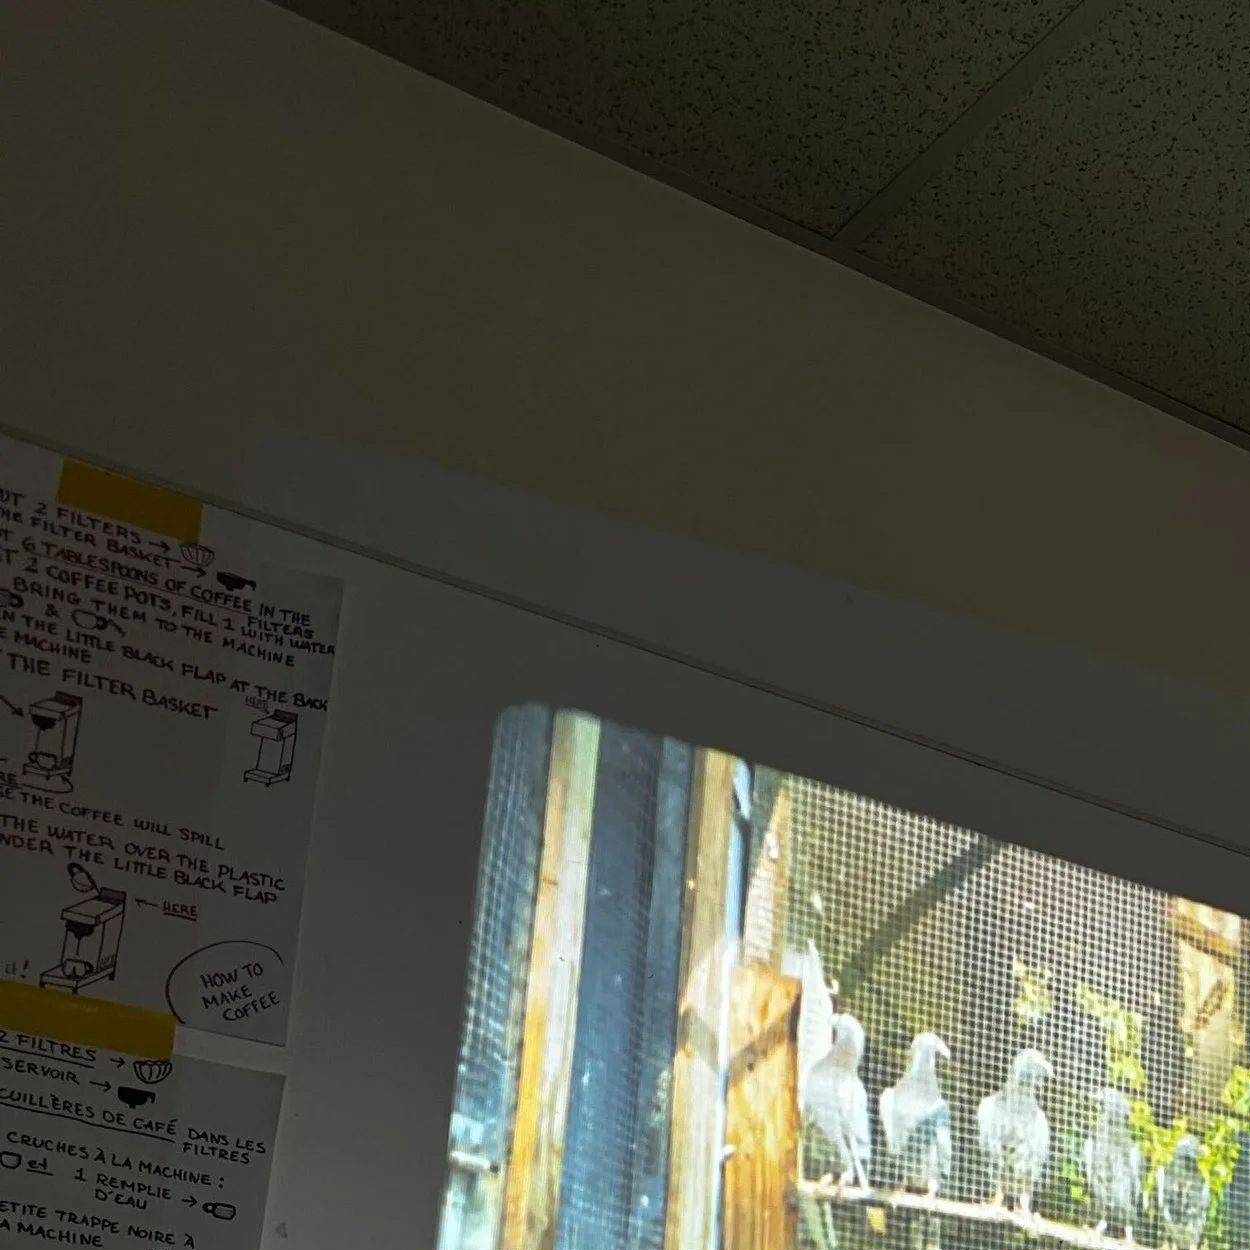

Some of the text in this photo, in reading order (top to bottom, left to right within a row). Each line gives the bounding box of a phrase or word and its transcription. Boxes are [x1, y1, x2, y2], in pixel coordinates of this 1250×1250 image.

[32, 517, 97, 548] FILTER
[107, 539, 181, 569] BASKET
[34, 502, 47, 515] 2
[57, 507, 141, 544] FILTERS
[22, 537, 36, 552] 6
[41, 541, 159, 586] TABLESPOONS
[165, 578, 186, 592] OF
[190, 585, 252, 612] COFFEE
[259, 604, 275, 617] IN
[280, 610, 310, 627] THE
[13, 577, 296, 667] BRING THEM TO THE MACHINE
[24, 558, 38, 574] 2
[46, 564, 118, 595] COFFEE
[182, 606, 216, 625] FILL
[223, 617, 235, 630] 1
[242, 627, 283, 646] WITH
[290, 640, 335, 656] WATER
[45, 604, 59, 618] &
[247, 616, 314, 639] FILTERS
[14, 631, 91, 664] MACHINE
[24, 616, 57, 636] THE
[67, 629, 115, 652] LITTLE
[121, 646, 174, 671] BLACK
[182, 664, 226, 684] FLAP
[229, 680, 250, 693] AT
[255, 686, 288, 704] THE
[293, 693, 328, 711] BACK
[7, 653, 219, 720] THE FILTER BASKET
[20, 791, 54, 809] THE
[59, 802, 123, 827] COFFEE
[134, 818, 172, 836] WILL
[179, 827, 225, 850] SPILL
[47, 825, 115, 850] WATER
[125, 842, 170, 863] OVER
[175, 854, 209, 874] THE
[218, 864, 286, 891] PLASTIC
[64, 845, 104, 866] THE
[113, 857, 167, 880] LITTLE
[174, 870, 226, 893] BLACK
[232, 885, 277, 905] FLAP
[163, 900, 198, 917] HERE
[200, 962, 263, 988] HOW TO
[201, 985, 252, 1009] MAKE
[223, 991, 280, 1022] COFFEE
[17, 1034, 97, 1062] FILTRES
[2, 1057, 80, 1084] SERVOIR
[103, 1110, 126, 1125] DE
[133, 1118, 177, 1136] CAFÉ
[188, 1128, 229, 1146] DANS
[235, 1138, 266, 1154] LES
[7, 1131, 89, 1159] CRUCHES
[94, 1147, 106, 1162] À
[112, 1153, 133, 1170] LA
[138, 1161, 211, 1186] MACHINE
[183, 1142, 251, 1165] FILTRES
[27, 1158, 171, 1200] et 1 REMPLIE
[95, 1189, 147, 1210] D'EAU
[17, 1222, 103, 1248] MACHINE
[56, 1209, 120, 1234] TRAPPE
[128, 1225, 175, 1245] NOIRE
[184, 1233, 195, 1249] À
